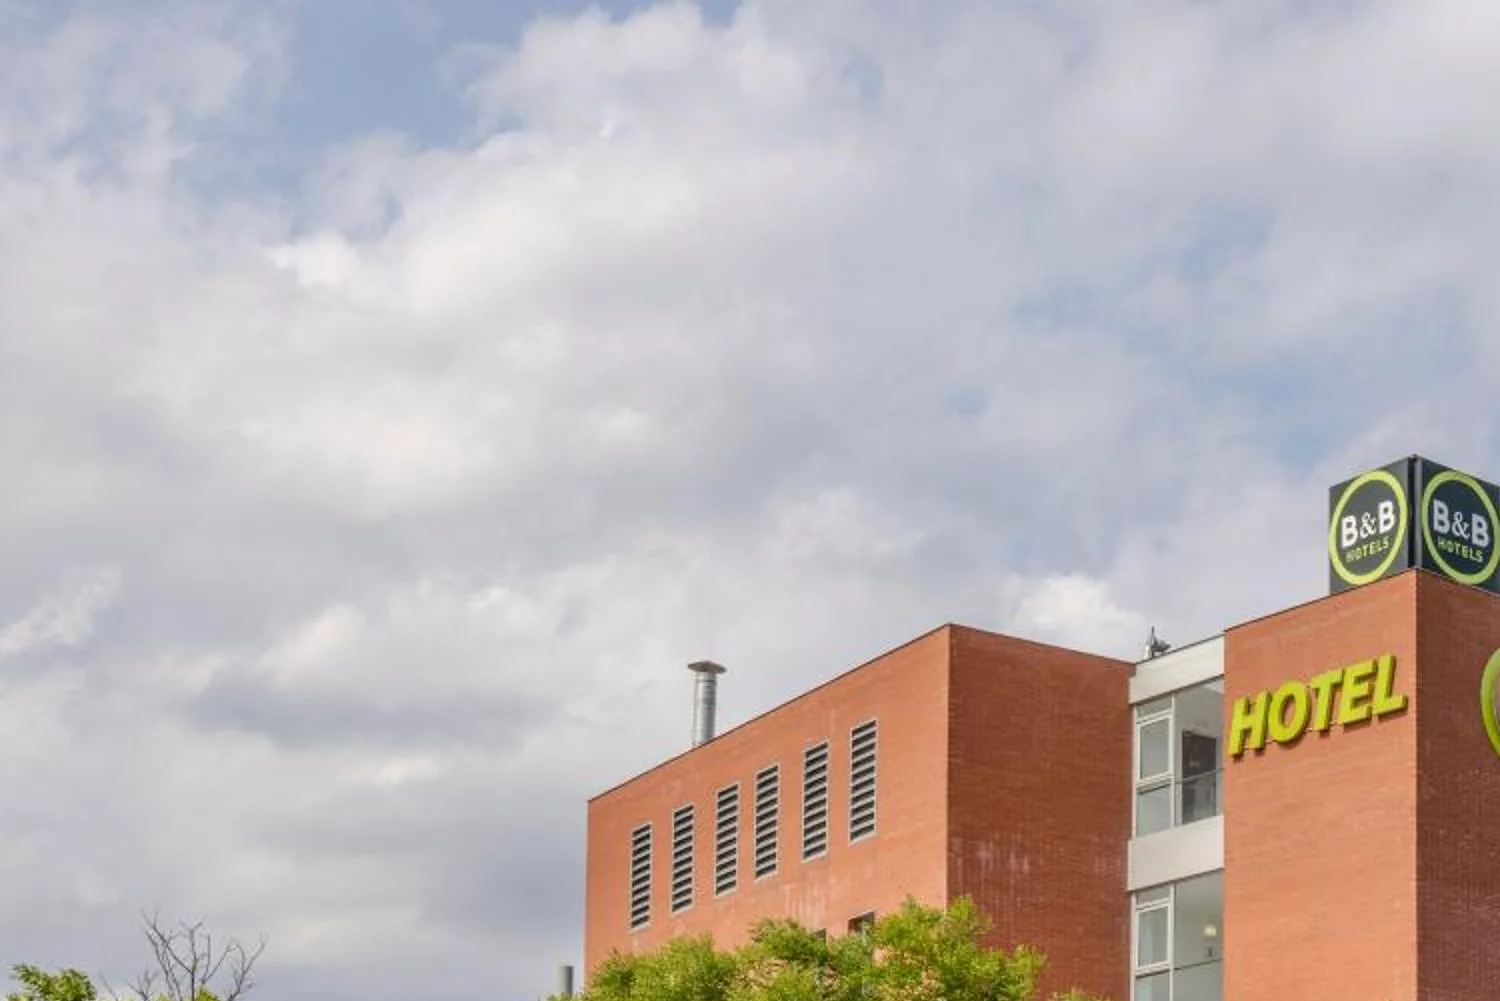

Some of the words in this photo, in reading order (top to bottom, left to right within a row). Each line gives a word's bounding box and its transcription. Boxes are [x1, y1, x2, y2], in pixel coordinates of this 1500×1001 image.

[1341, 500, 1395, 549] B&B
[1433, 500, 1490, 547] B&B
[1346, 537, 1390, 563] HOTELS
[1437, 536, 1484, 563] HOTELS
[1228, 654, 1409, 758] HOTEL
